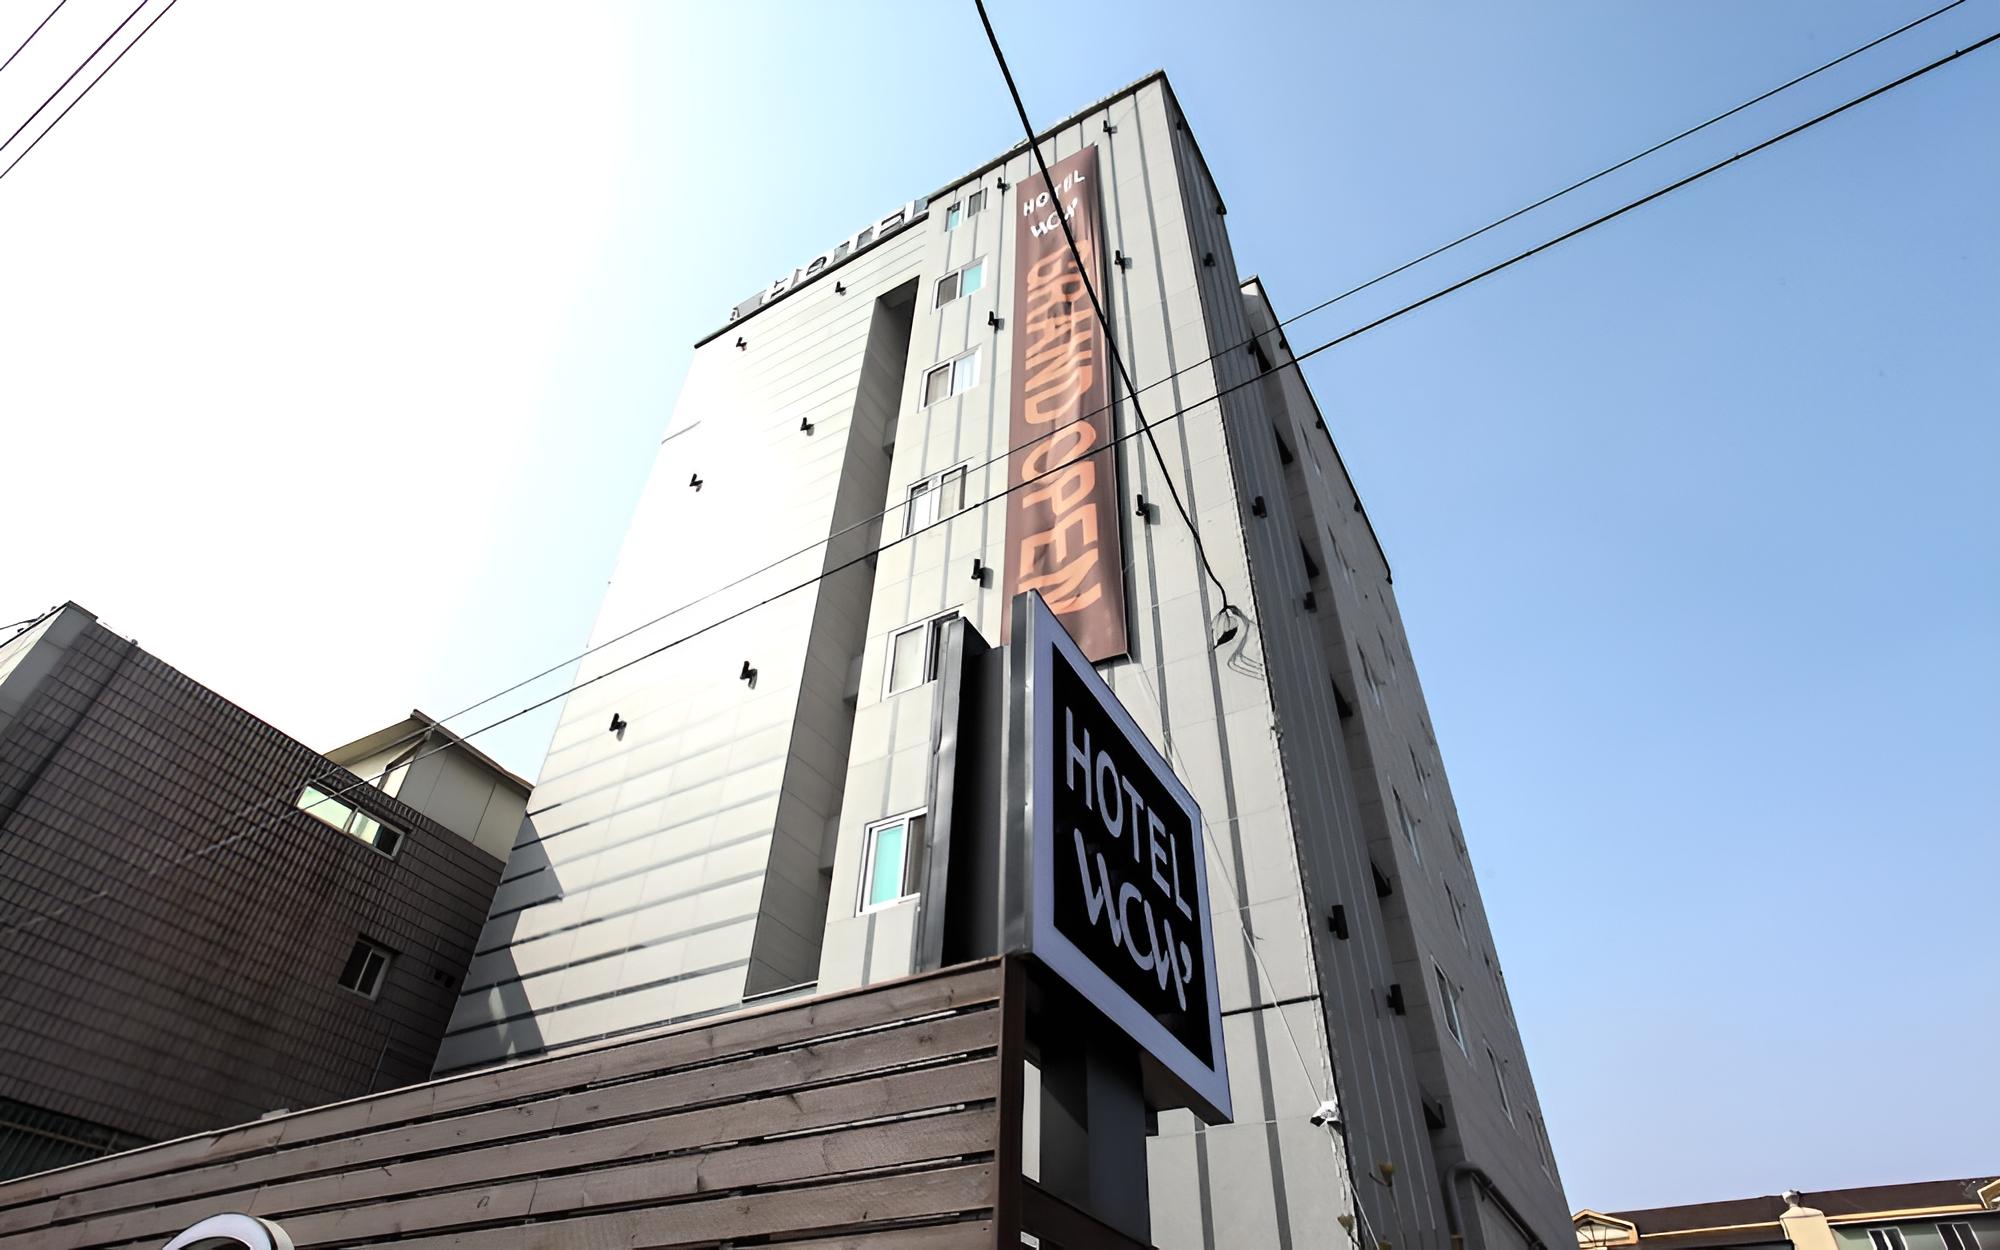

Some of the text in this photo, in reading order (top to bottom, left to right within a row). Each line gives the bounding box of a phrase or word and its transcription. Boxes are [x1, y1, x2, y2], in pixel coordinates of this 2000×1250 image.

[1018, 239, 1102, 615] GRAND OPEN
[1065, 706, 1193, 922] HOTEL
